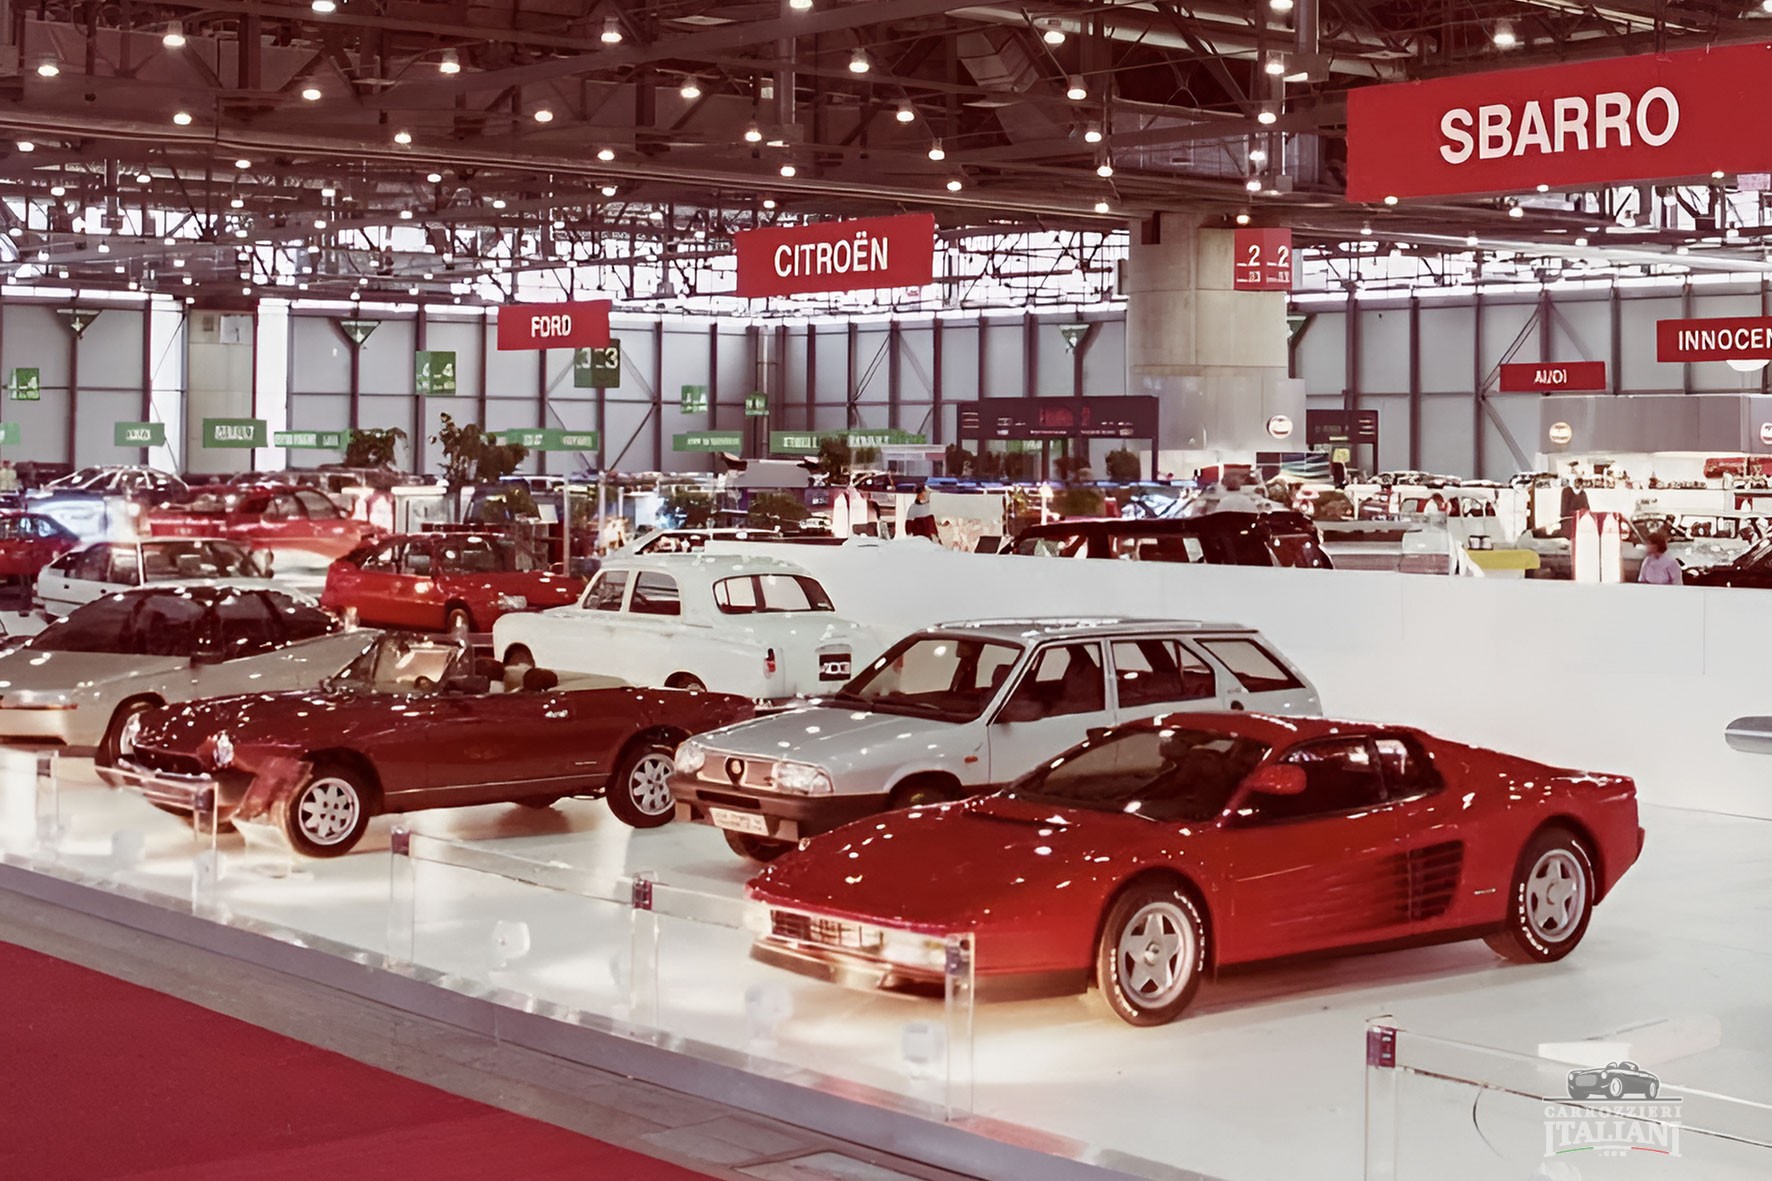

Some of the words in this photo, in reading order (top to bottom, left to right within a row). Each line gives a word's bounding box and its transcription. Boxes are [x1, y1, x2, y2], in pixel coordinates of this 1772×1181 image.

[1439, 86, 1679, 164] SBARRO
[774, 231, 888, 277] CITROËN
[1248, 244, 1260, 267] 2
[1277, 245, 1289, 268] 2
[531, 314, 571, 338] FORD
